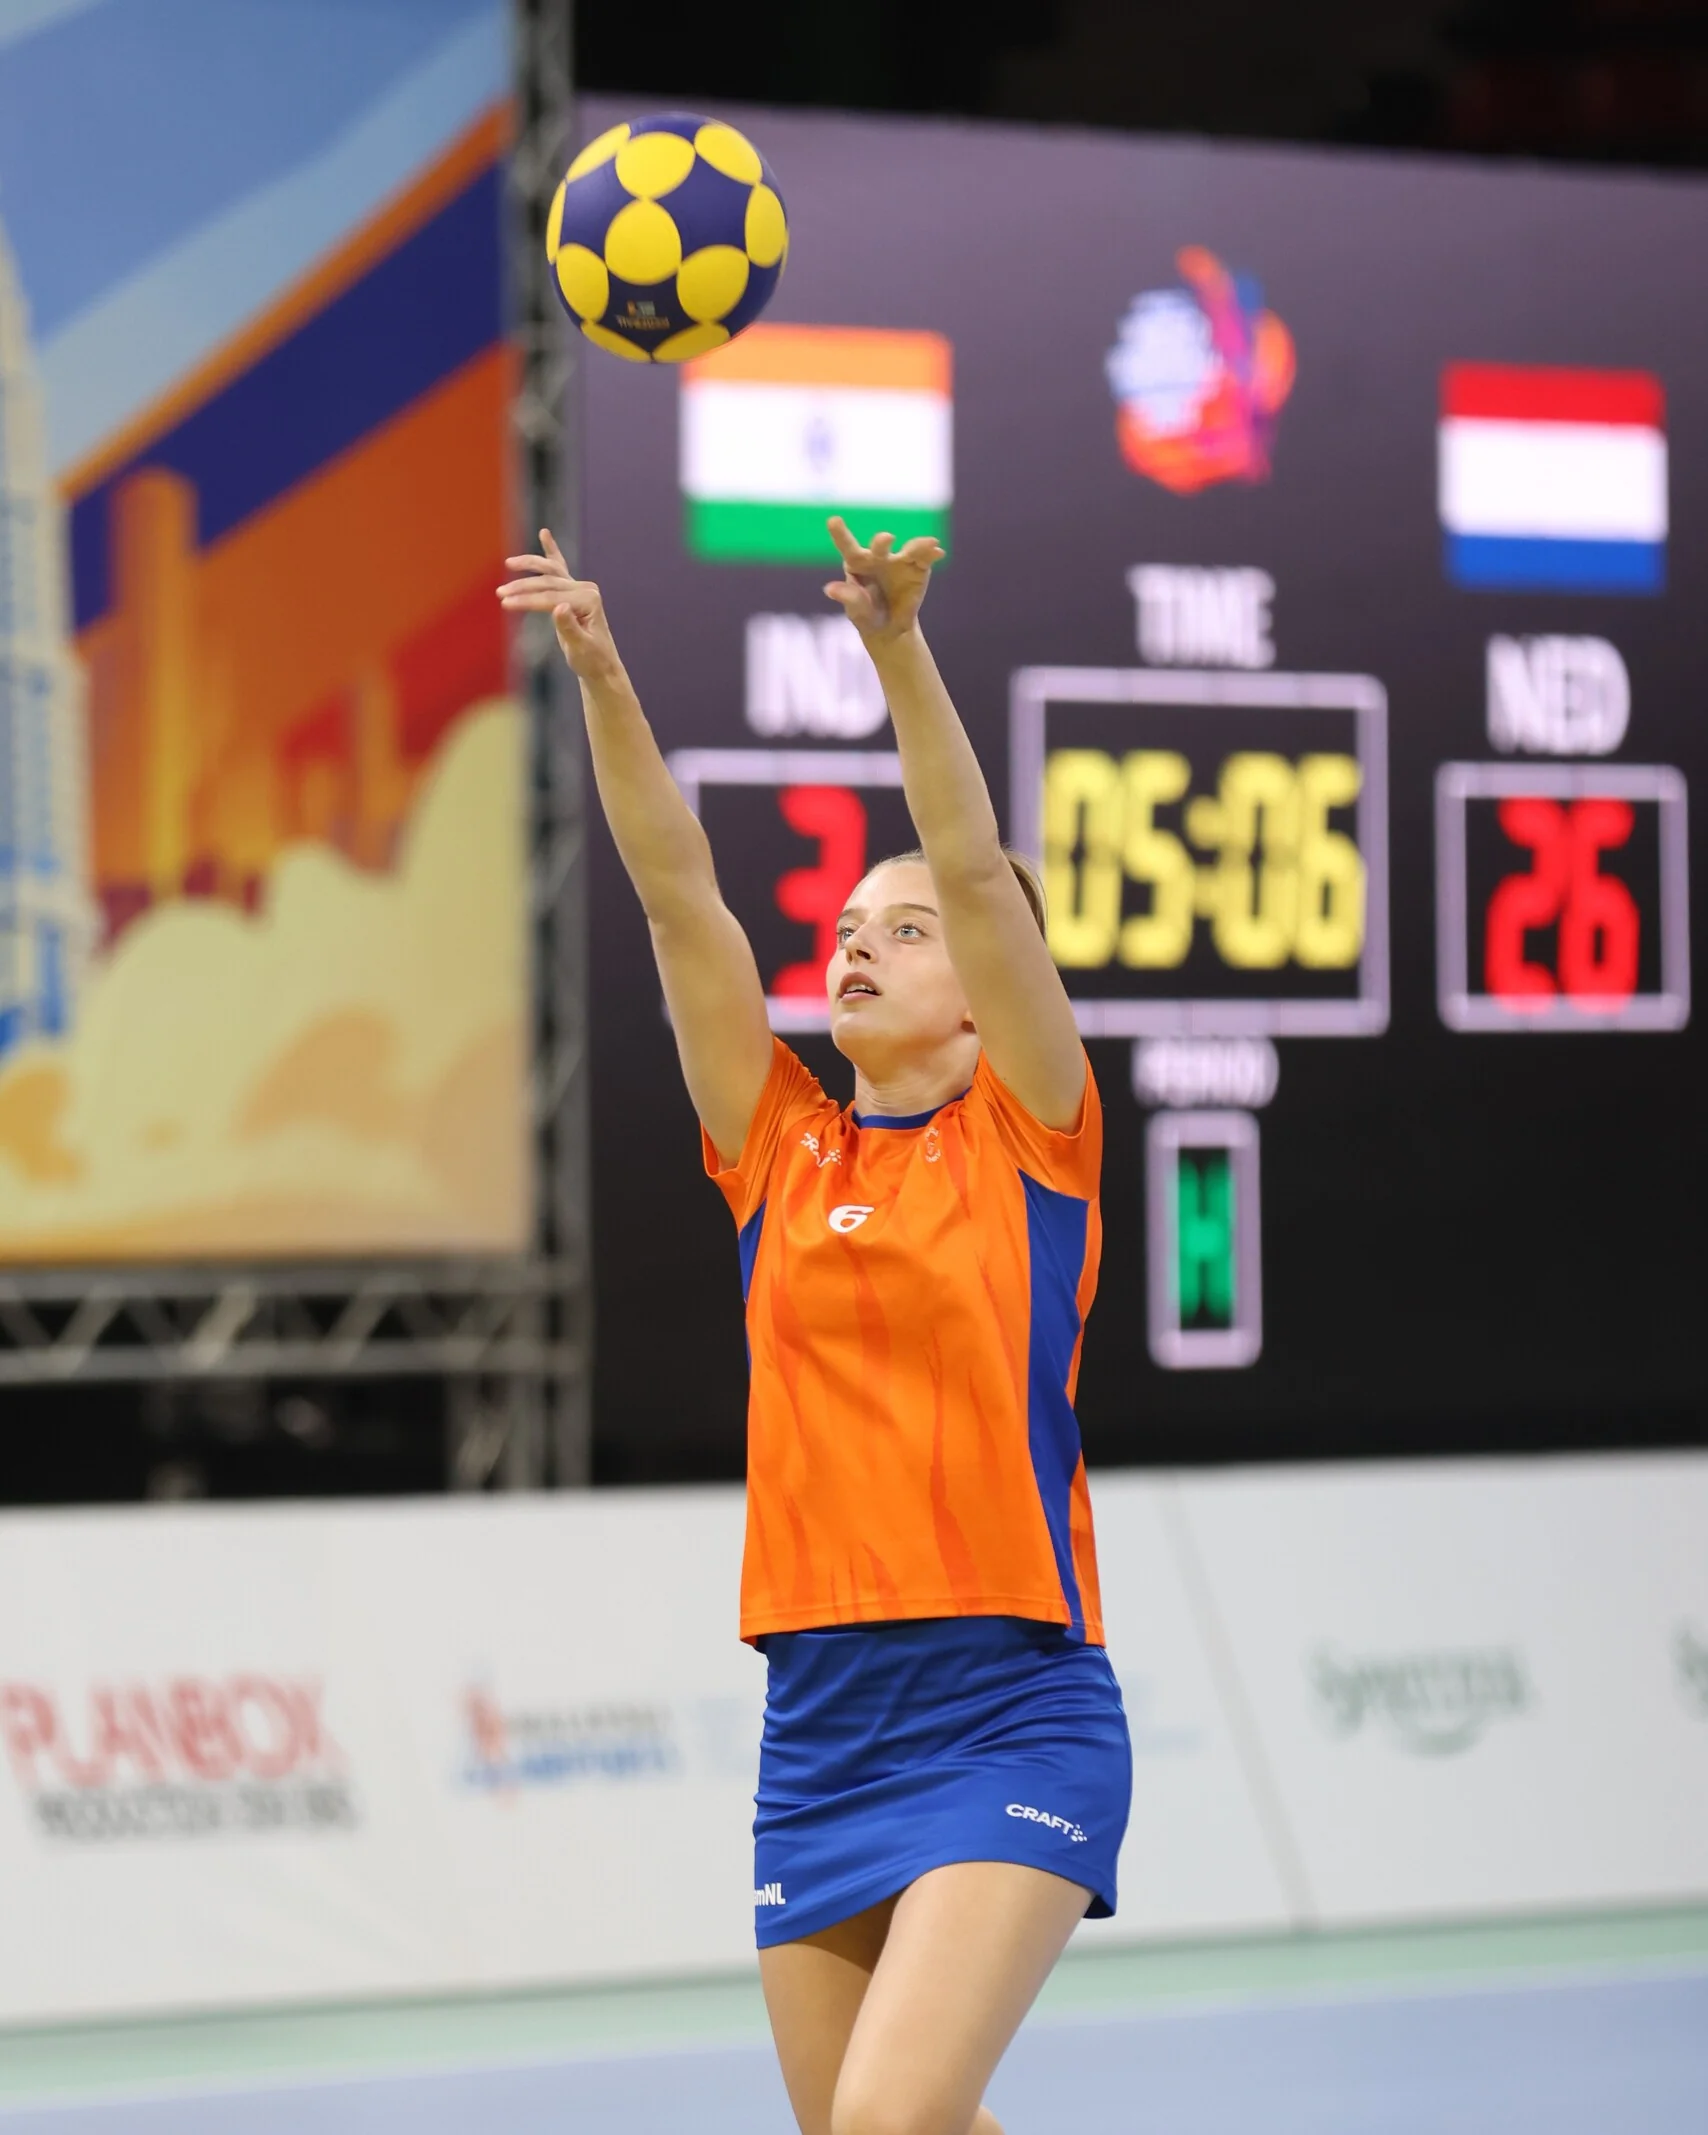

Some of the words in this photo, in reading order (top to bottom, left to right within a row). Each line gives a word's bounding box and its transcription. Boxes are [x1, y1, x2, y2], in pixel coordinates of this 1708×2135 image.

[746, 613, 889, 738] IND
[1126, 565, 1276, 668] TIME
[1487, 635, 1631, 755] NED
[773, 785, 866, 1015] 3
[1043, 748, 1367, 969] 05:06
[1486, 797, 1640, 1014] 26
[828, 1205, 874, 1233] 6
[1005, 1803, 1074, 1835] CRAFT
